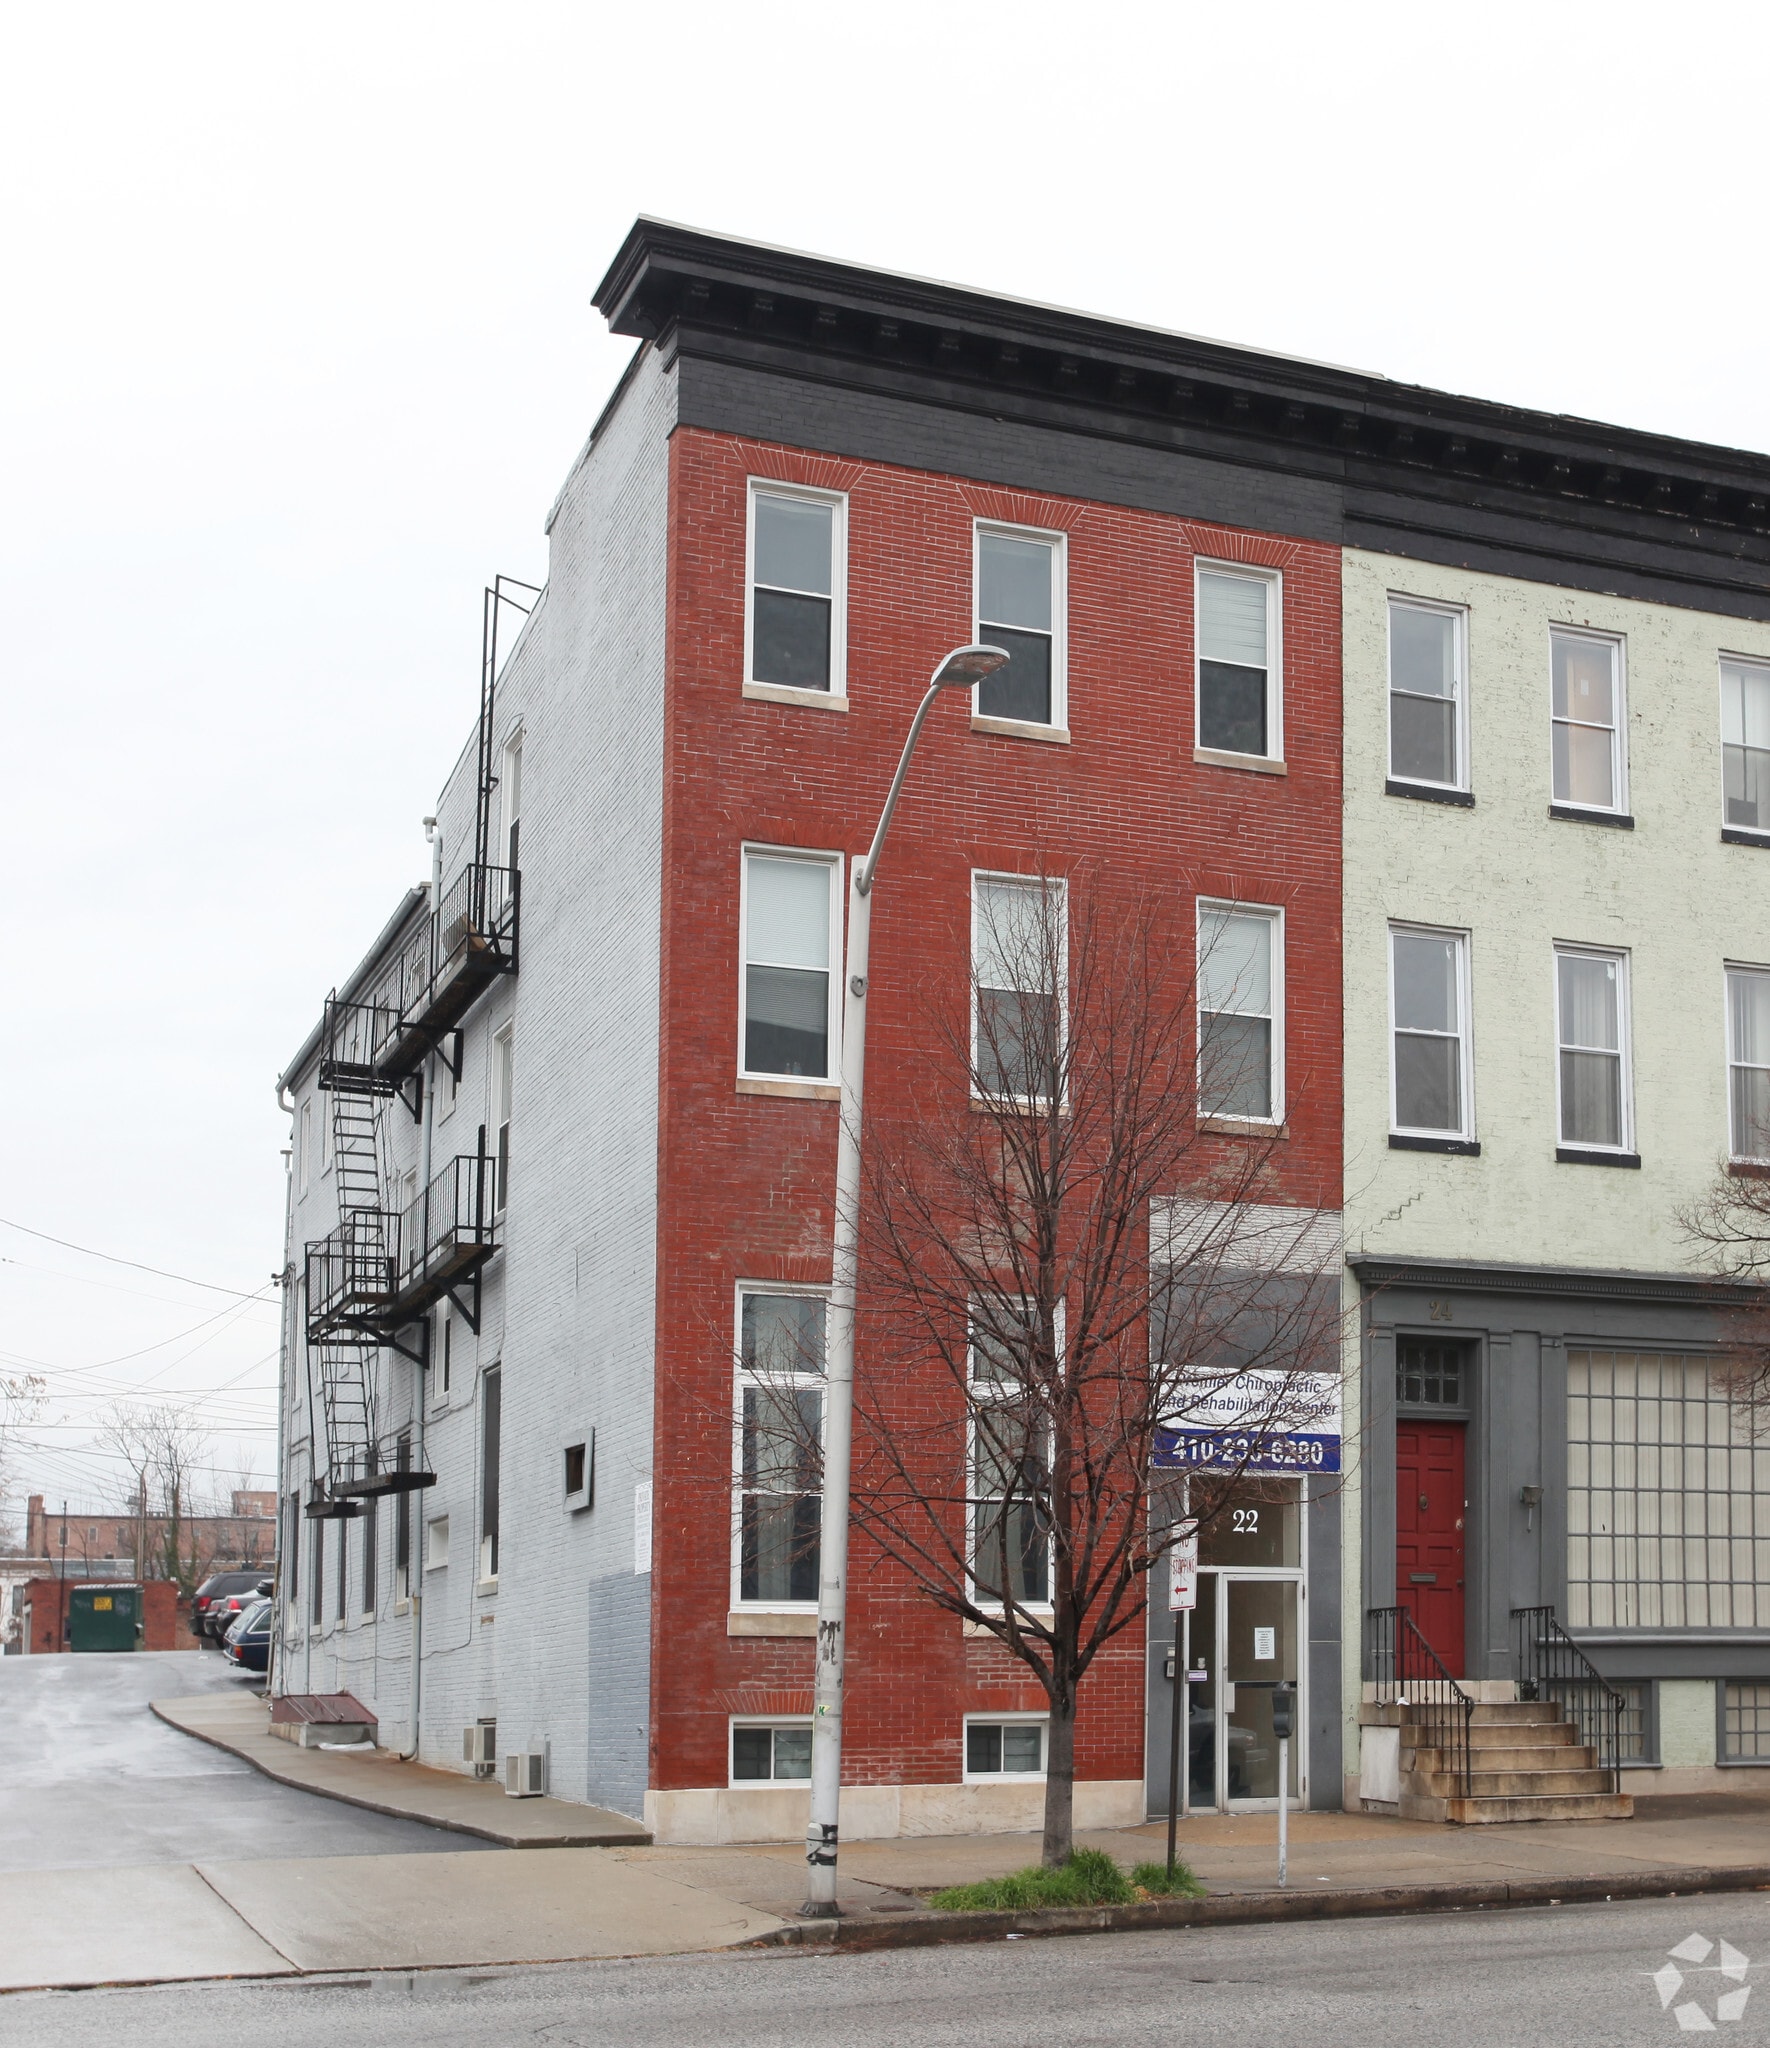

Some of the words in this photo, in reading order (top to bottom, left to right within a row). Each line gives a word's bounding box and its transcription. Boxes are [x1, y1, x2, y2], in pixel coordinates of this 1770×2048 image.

[1429, 1299, 1453, 1321] 24
[1177, 1372, 1229, 1389] Pemier
[1235, 1375, 1321, 1395] Chiropactic
[1157, 1394, 1186, 1409] nd
[1232, 1509, 1259, 1534] 22
